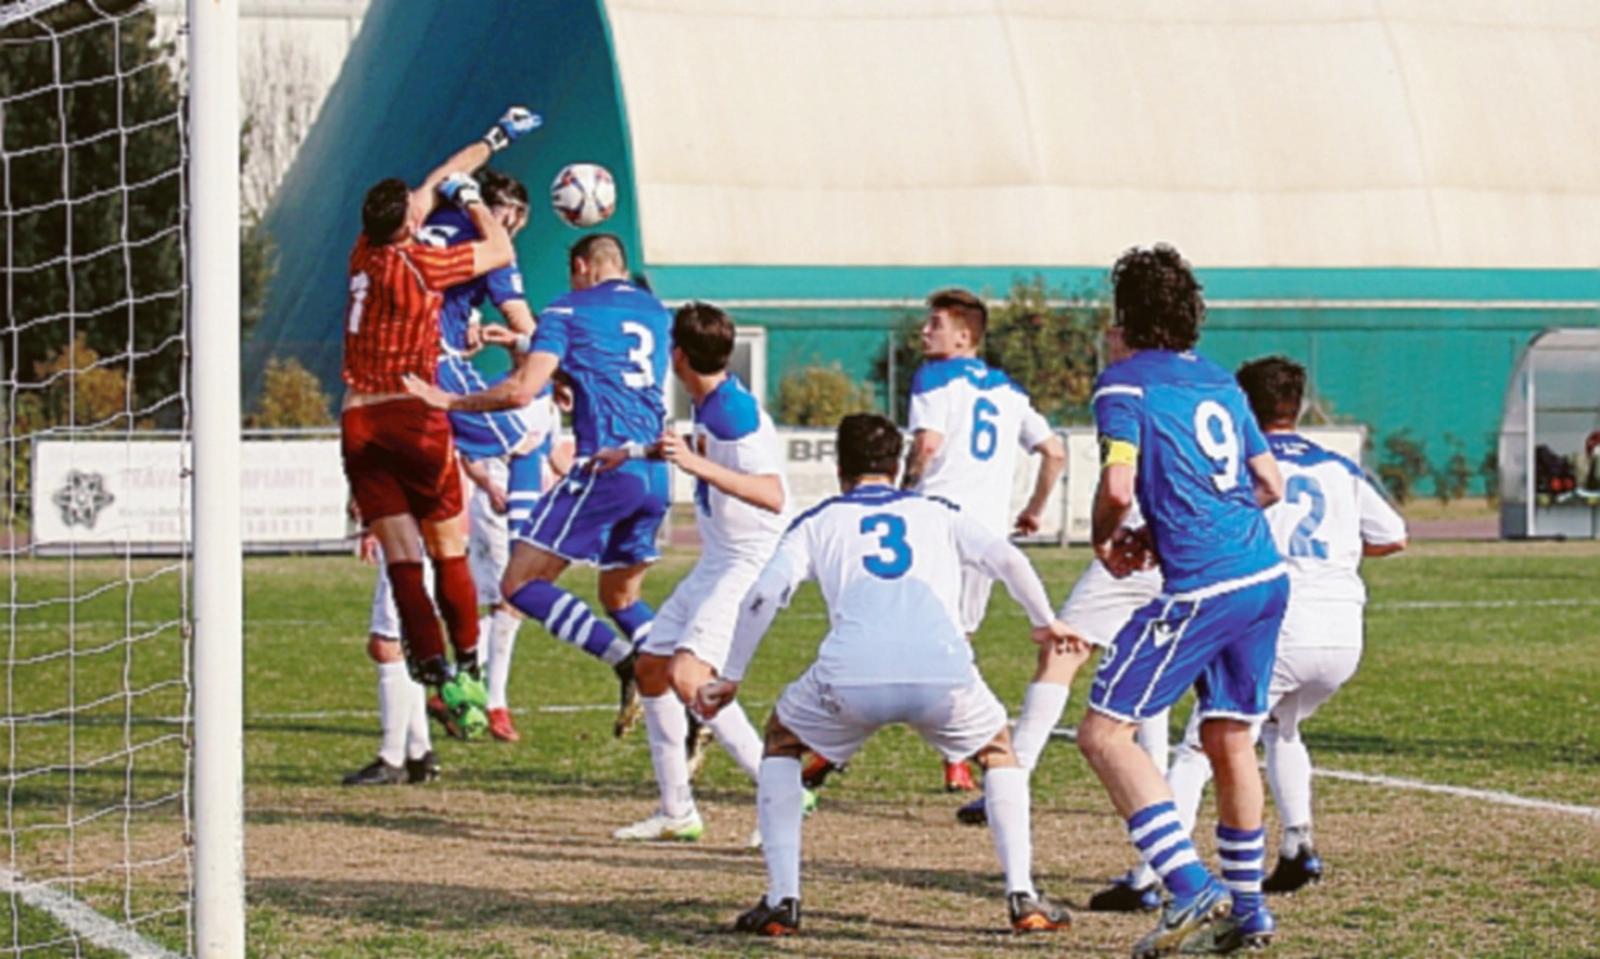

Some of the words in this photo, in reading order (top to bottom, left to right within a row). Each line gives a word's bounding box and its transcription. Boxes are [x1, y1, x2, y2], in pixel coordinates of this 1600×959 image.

[349, 269, 370, 334] 1
[620, 321, 656, 389] 3
[969, 396, 1000, 462] 6
[1193, 399, 1240, 493] 9
[859, 512, 914, 580] 3
[1285, 473, 1330, 562] 2
